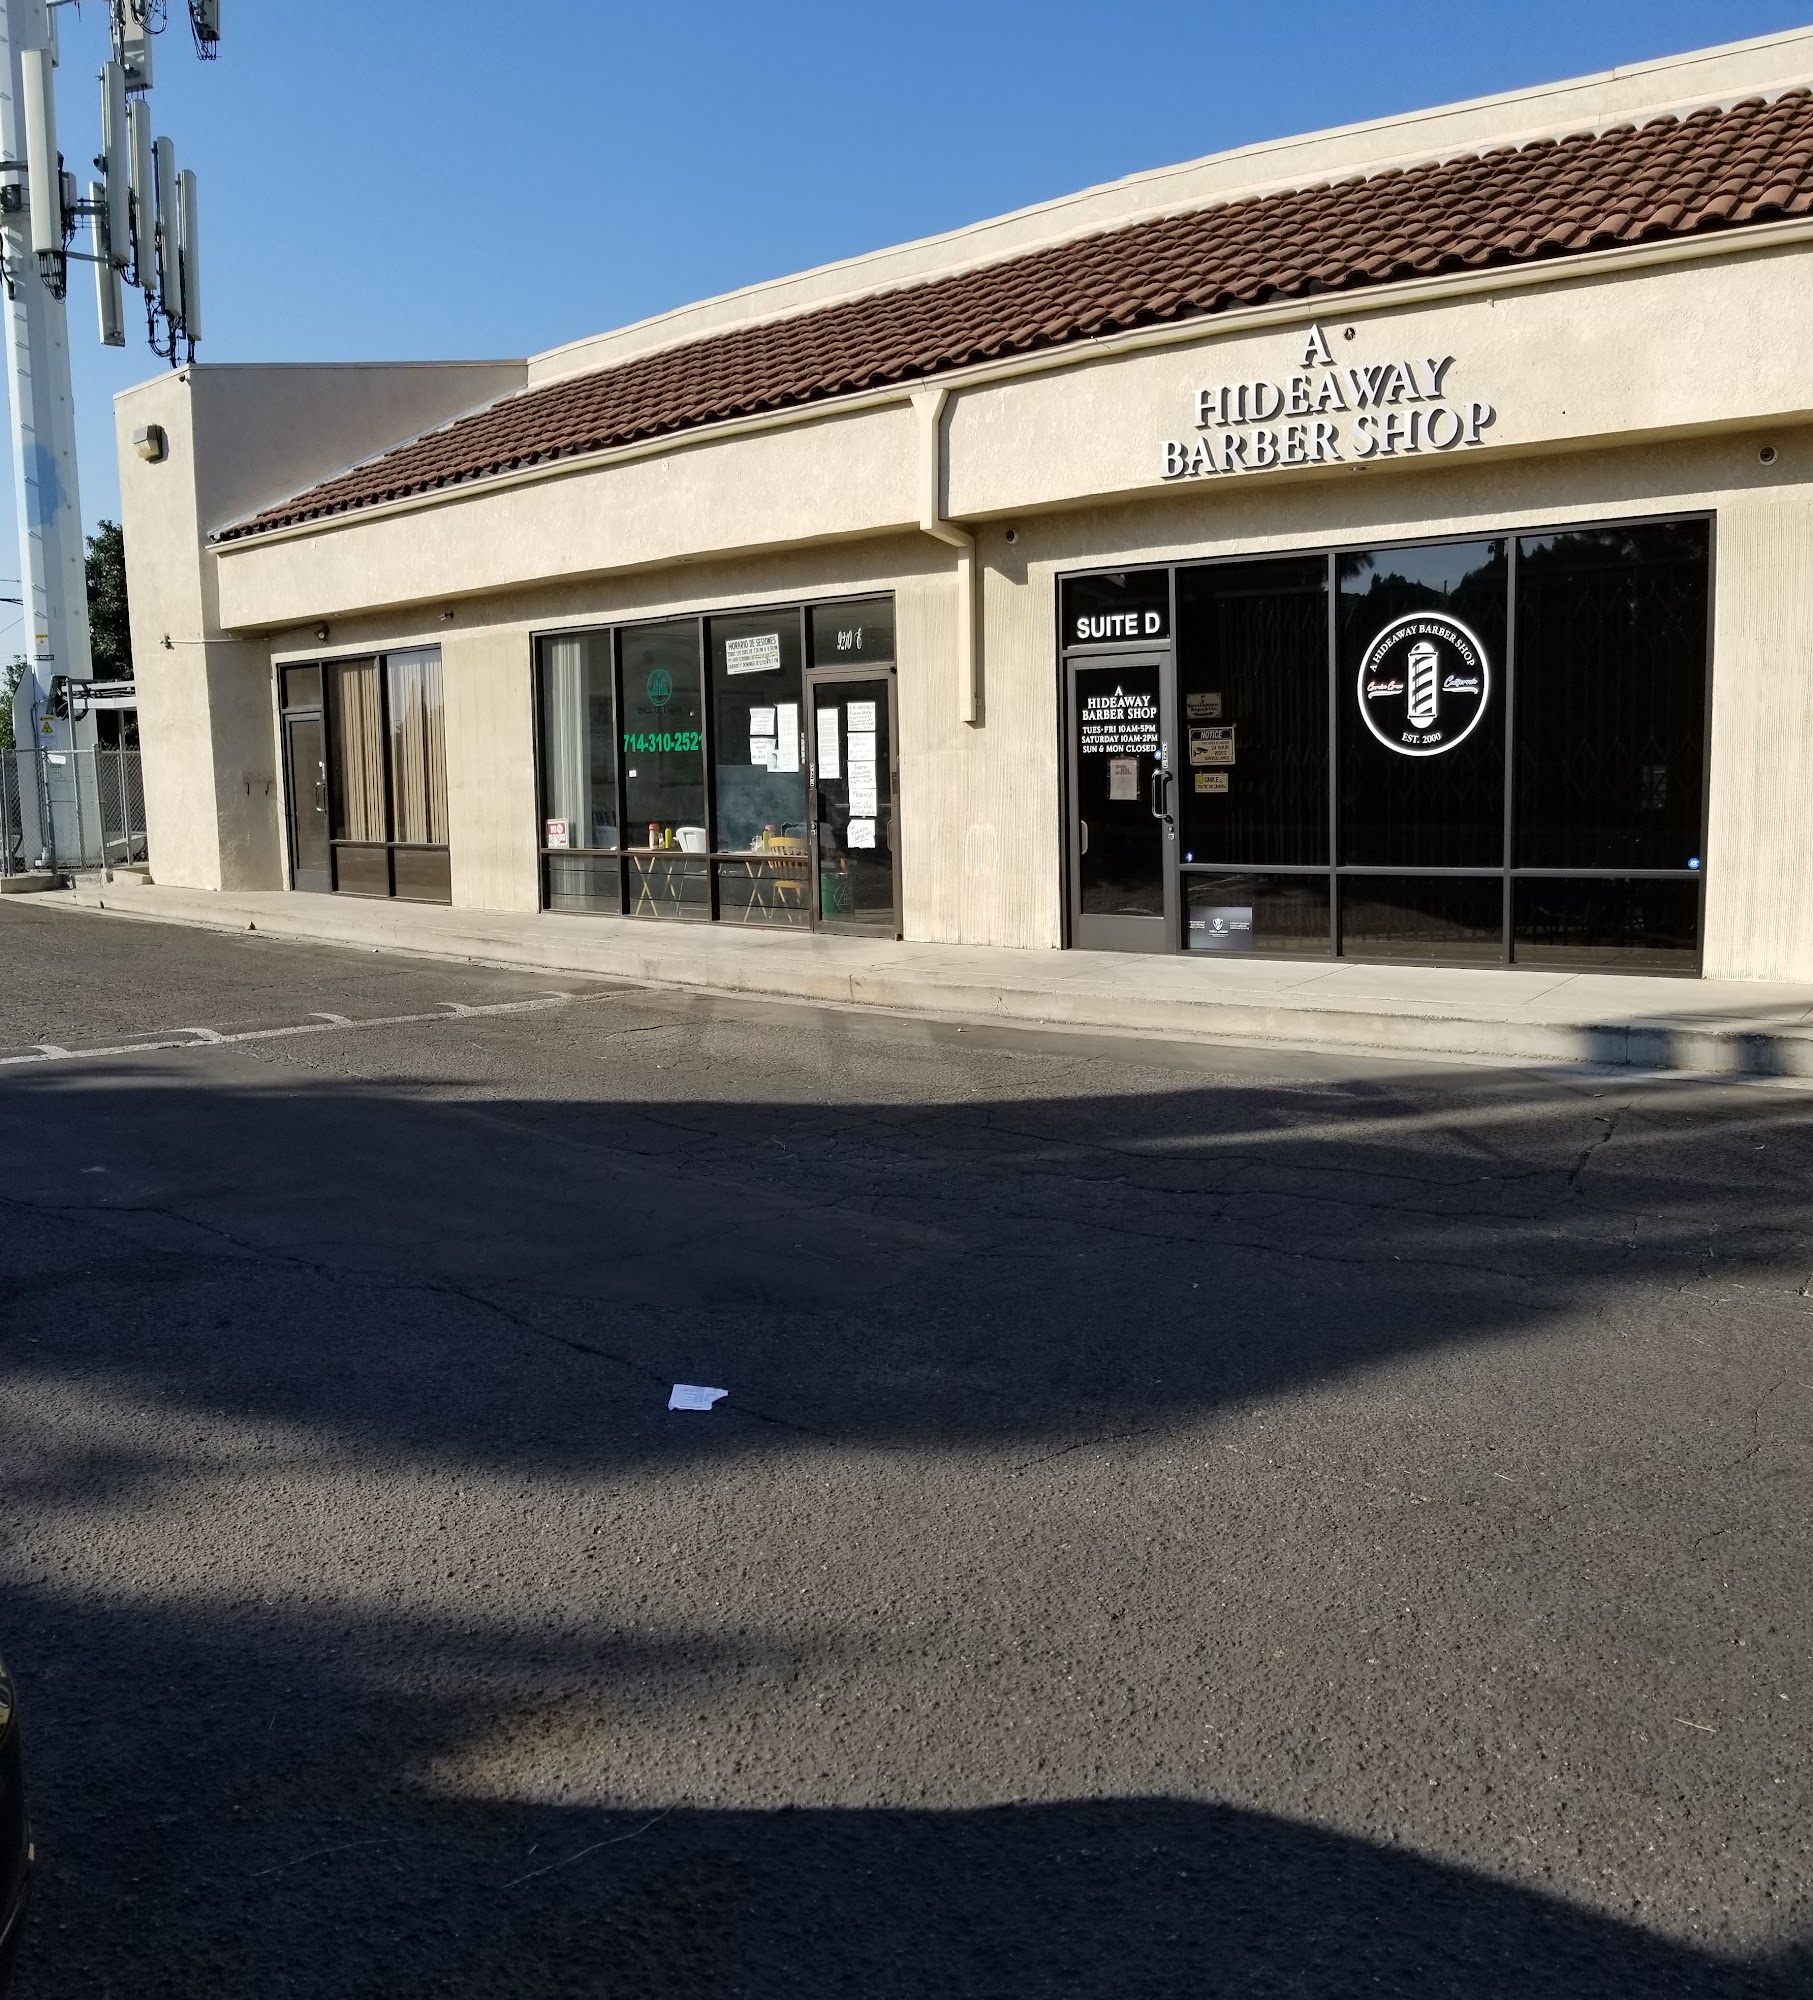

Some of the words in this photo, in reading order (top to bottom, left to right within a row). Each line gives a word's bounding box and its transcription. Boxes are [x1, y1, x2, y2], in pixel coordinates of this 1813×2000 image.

[1300, 323, 1333, 367] A
[1192, 356, 1456, 428] HIDEAWAY
[1159, 420, 1341, 479] BARBER
[1352, 401, 1496, 458] SHOP
[1076, 613, 1139, 639] SUITE
[1144, 612, 1160, 634] D
[1418, 624, 1456, 644] BARBER
[1373, 625, 1418, 664] HIDEAWAY
[1454, 639, 1475, 666] SHOP
[1370, 664, 1378, 673] A
[1114, 686, 1123, 696] A
[1087, 695, 1151, 709] HIDEAWAY
[1082, 709, 1124, 720] BARBER
[1127, 707, 1157, 719] SHOP
[1118, 724, 1156, 733] 10AM-5PM
[1200, 730, 1222, 739] NOTICE
[1081, 735, 1119, 743] SATURDAY
[1120, 734, 1158, 743] 10AM-2PM
[1401, 732, 1419, 744] EST.
[1421, 732, 1441, 744] 2000
[1082, 745, 1097, 753] SUN
[1099, 745, 1104, 753] &
[1106, 744, 1124, 752] MON
[1125, 744, 1157, 752] CLOSED
